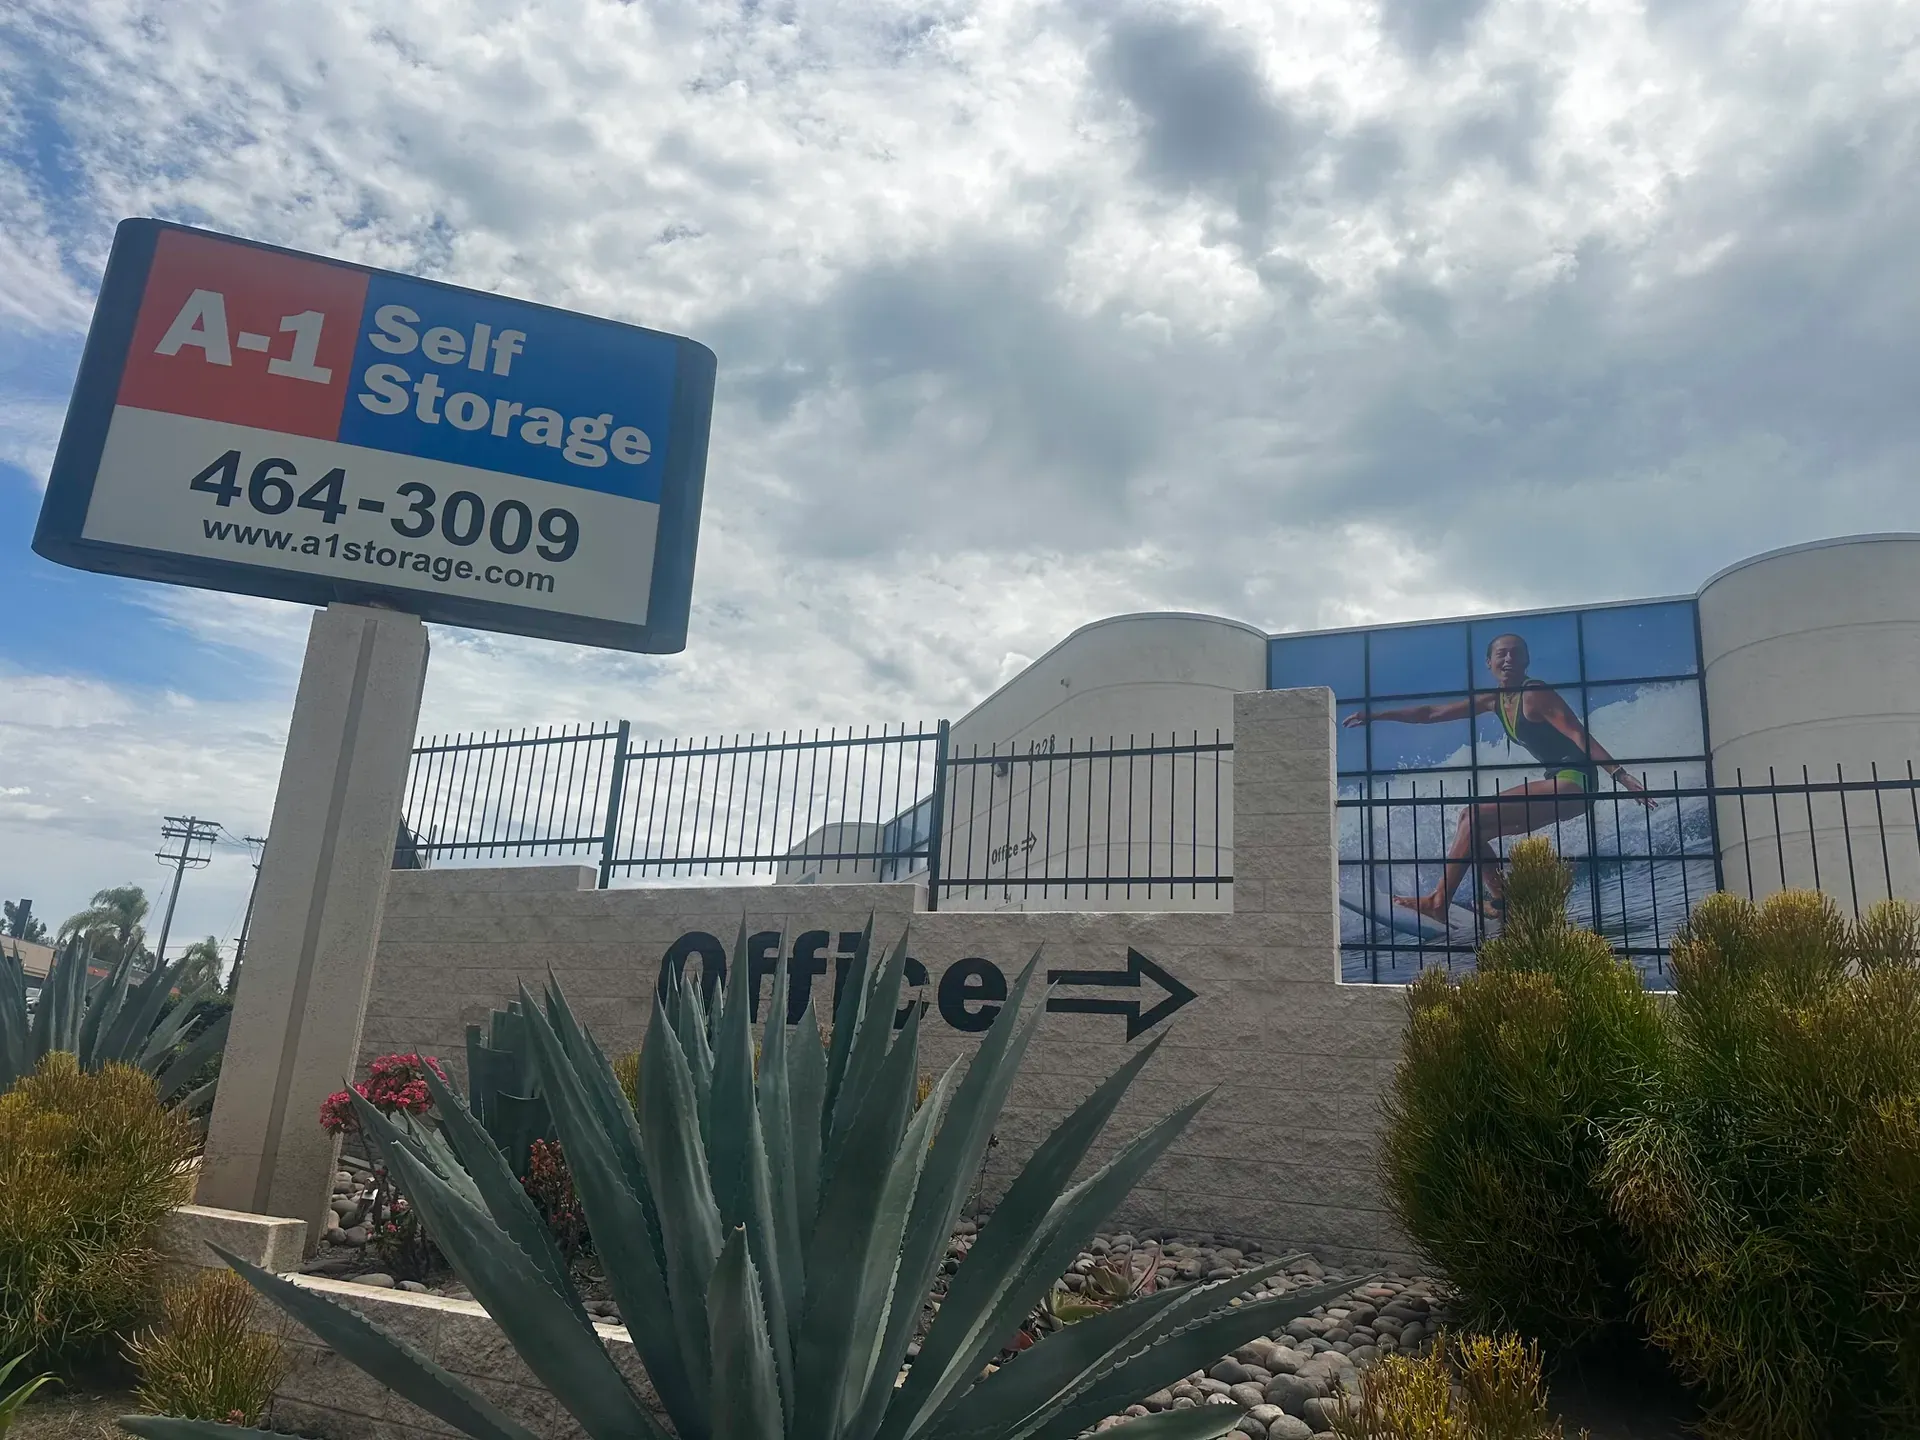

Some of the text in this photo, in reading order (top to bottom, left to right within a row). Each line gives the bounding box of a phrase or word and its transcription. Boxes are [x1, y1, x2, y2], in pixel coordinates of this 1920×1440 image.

[154, 289, 333, 385] A-1
[368, 305, 526, 377] Self
[358, 364, 652, 468] Storage
[190, 449, 580, 563] 464-3009
[203, 518, 556, 593] www.a1storage.com
